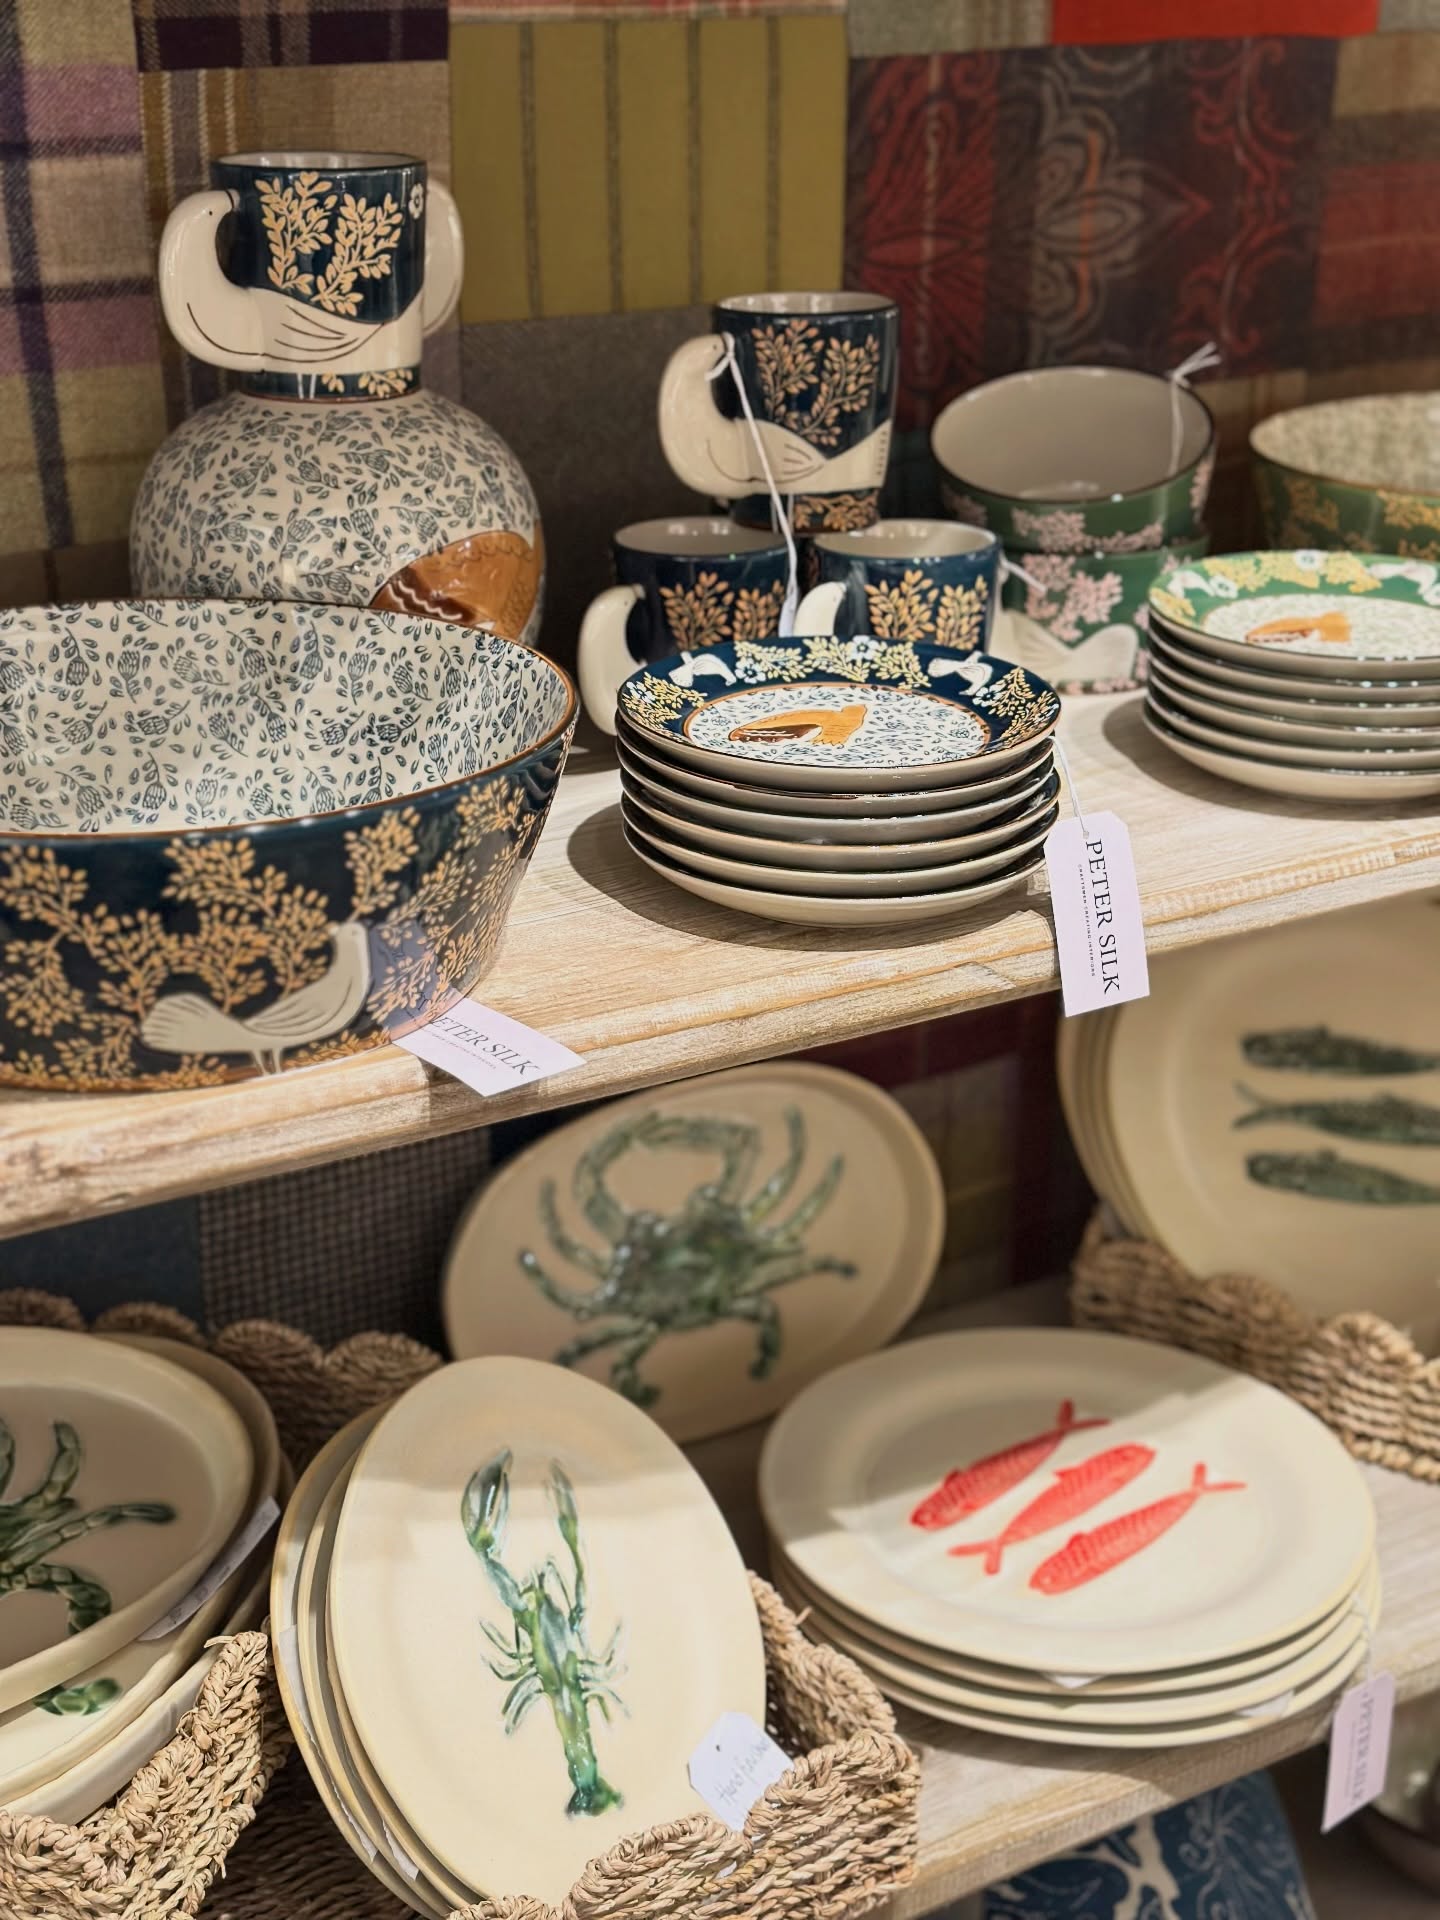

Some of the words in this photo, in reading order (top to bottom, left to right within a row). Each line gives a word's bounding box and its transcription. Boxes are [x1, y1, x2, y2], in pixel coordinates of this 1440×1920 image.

[1086, 840, 1113, 929] PETER
[1099, 934, 1120, 995] SILK
[431, 1016, 489, 1047] ETER
[483, 1043, 541, 1076] SILK
